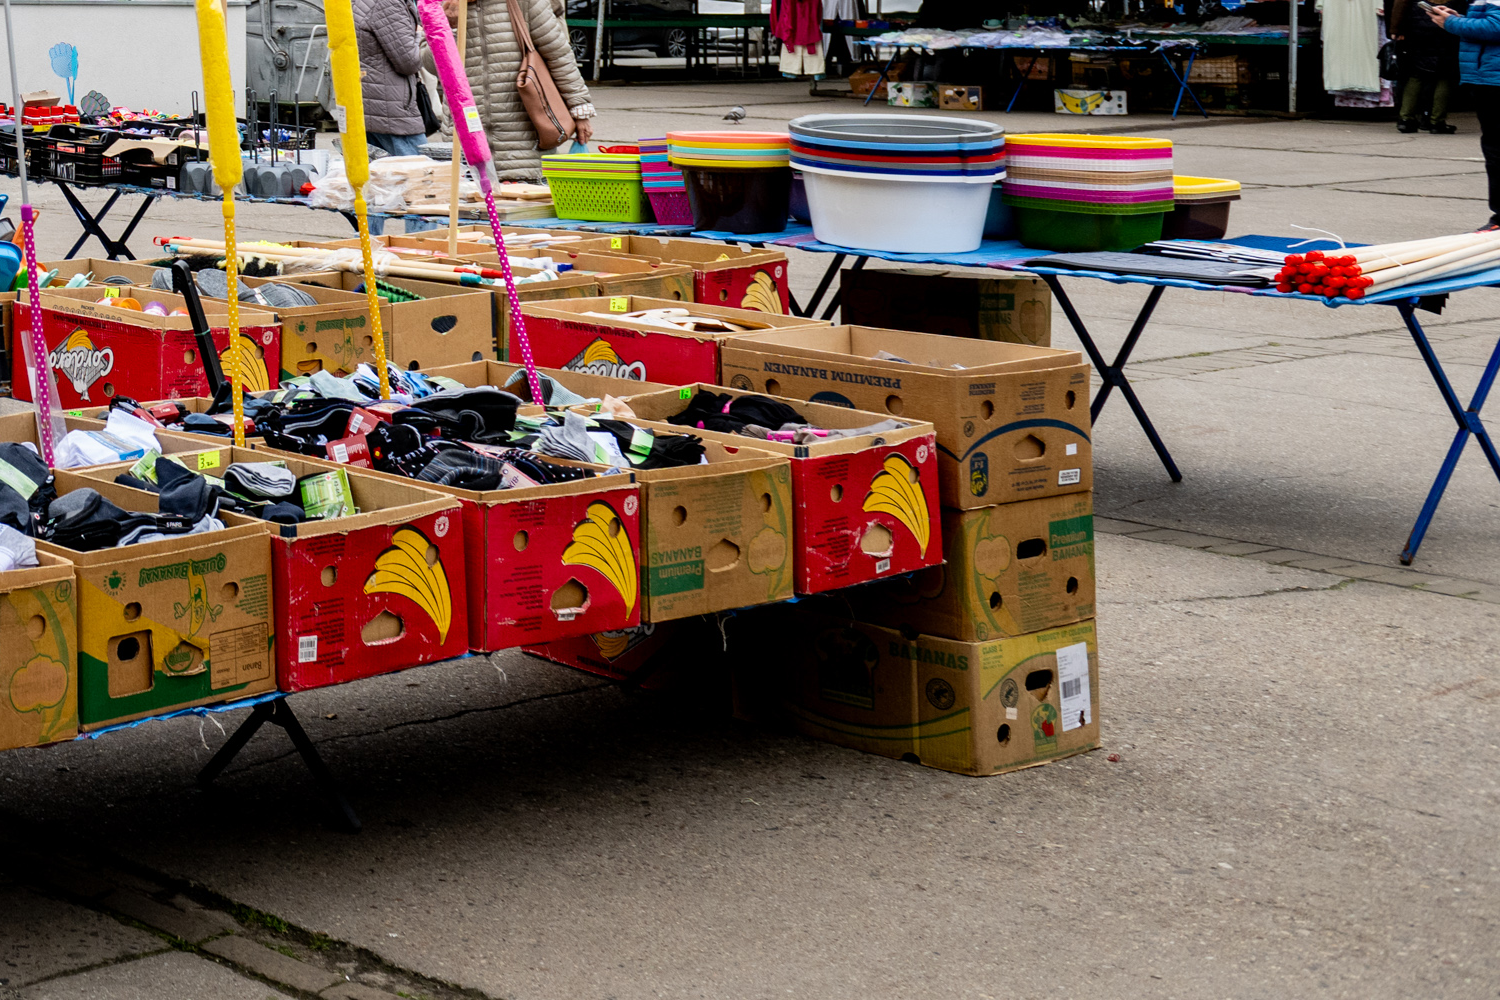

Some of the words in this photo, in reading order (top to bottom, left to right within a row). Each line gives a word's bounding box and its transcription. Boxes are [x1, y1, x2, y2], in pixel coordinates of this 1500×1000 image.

[563, 321, 598, 335] BANANAS
[598, 327, 636, 339] PREMIUM
[48, 347, 114, 377] Cordero
[763, 361, 828, 380] BANANEN
[831, 369, 902, 390] PREMIUM
[1051, 531, 1087, 546] Premium
[651, 546, 703, 565] BANANAS
[1052, 543, 1094, 561] BANANAS
[138, 561, 190, 587] BANANA!
[190, 554, 227, 577] QUIZA
[658, 564, 703, 579] Premium
[889, 642, 969, 671] BANANAS
[242, 661, 262, 672] Banan
